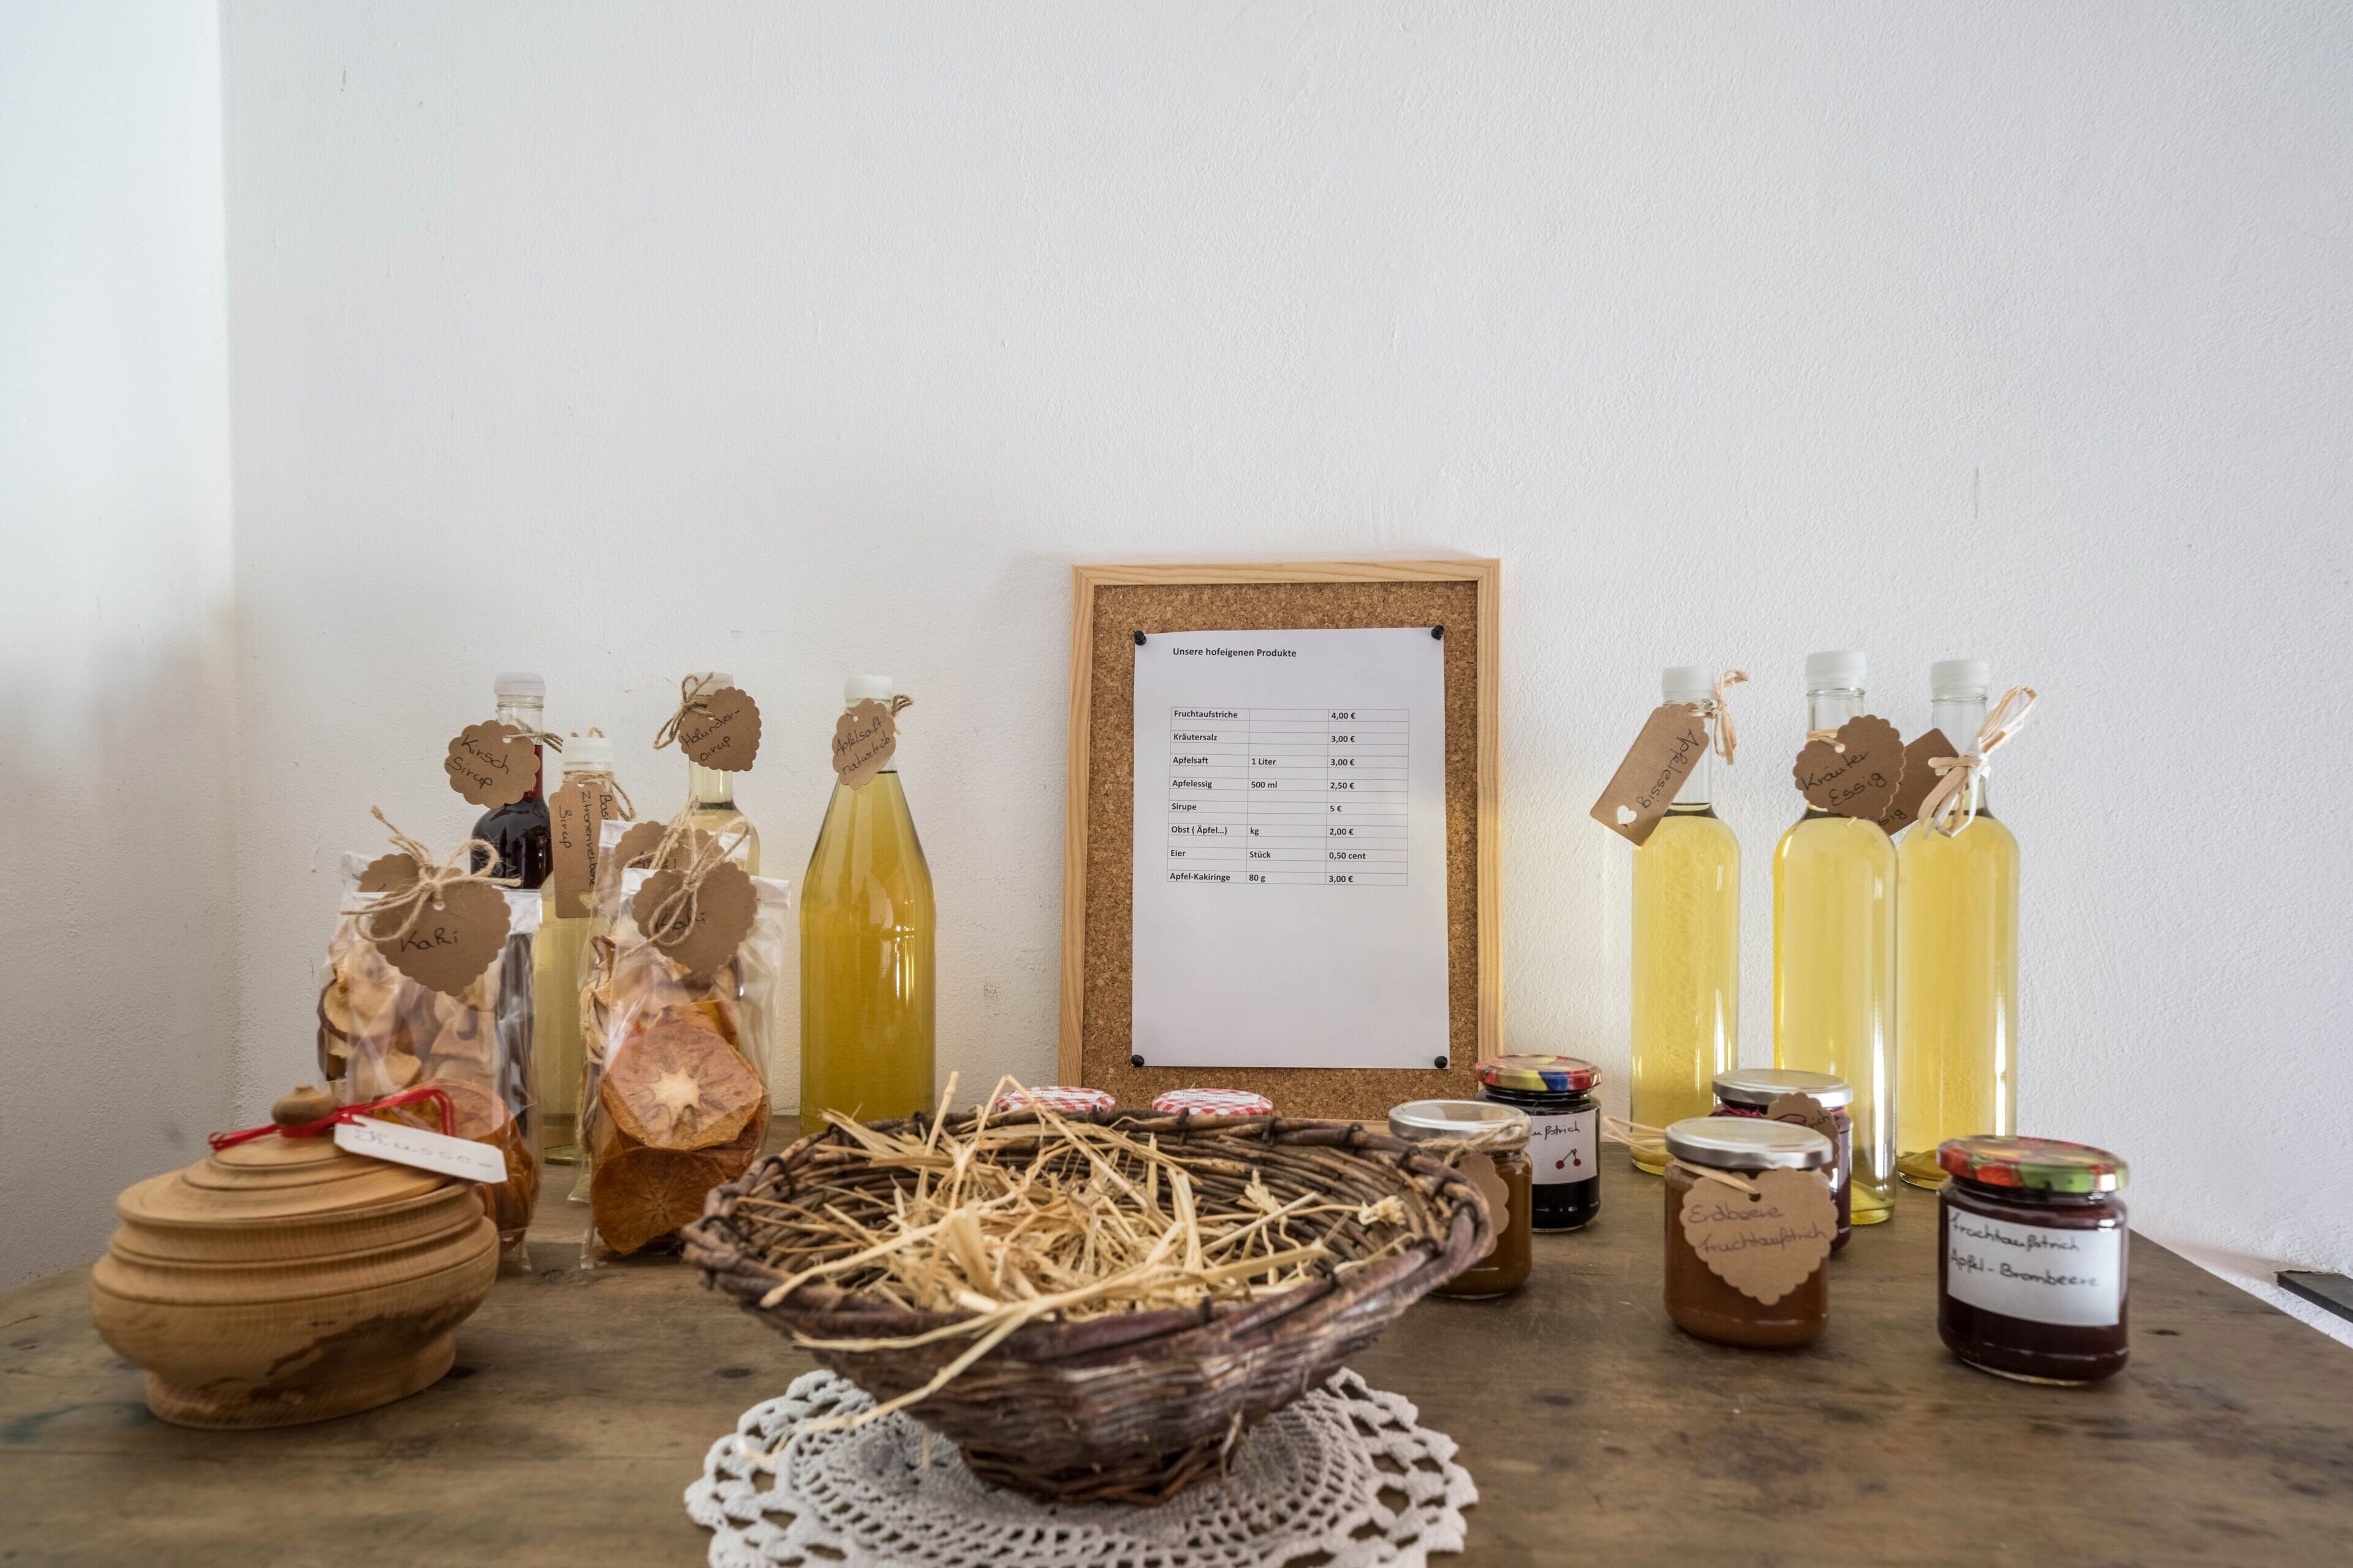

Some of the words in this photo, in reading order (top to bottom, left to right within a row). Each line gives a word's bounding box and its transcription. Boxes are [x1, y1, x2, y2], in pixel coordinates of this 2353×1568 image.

[1173, 648, 1203, 656] Unsere
[1205, 647, 1254, 658] hofeigenen
[1256, 648, 1297, 657] Produkte
[1331, 712, 1349, 721] 4,00
[836, 716, 882, 756] Apfelsaft
[1331, 735, 1348, 744] 3,00
[460, 735, 509, 775] Kirsch
[1172, 756, 1209, 765] Apfelsaft
[1330, 759, 1348, 767] 3,00
[446, 757, 493, 789] Sirup
[1636, 728, 1699, 809] Apfelessig
[1800, 751, 1868, 791] Kräuter
[1172, 779, 1213, 789] Apfelessig
[1330, 782, 1347, 790] 2,50
[1828, 772, 1887, 808] Essig
[1171, 803, 1197, 812] Sirupe
[1250, 827, 1260, 836] kg
[1329, 828, 1347, 836] 2,00
[1328, 852, 1347, 860] 0,50
[1170, 873, 1230, 882] Apfel-Kakiringe
[1328, 875, 1346, 884] 3,00
[1688, 1202, 1786, 1224] Erdbeere
